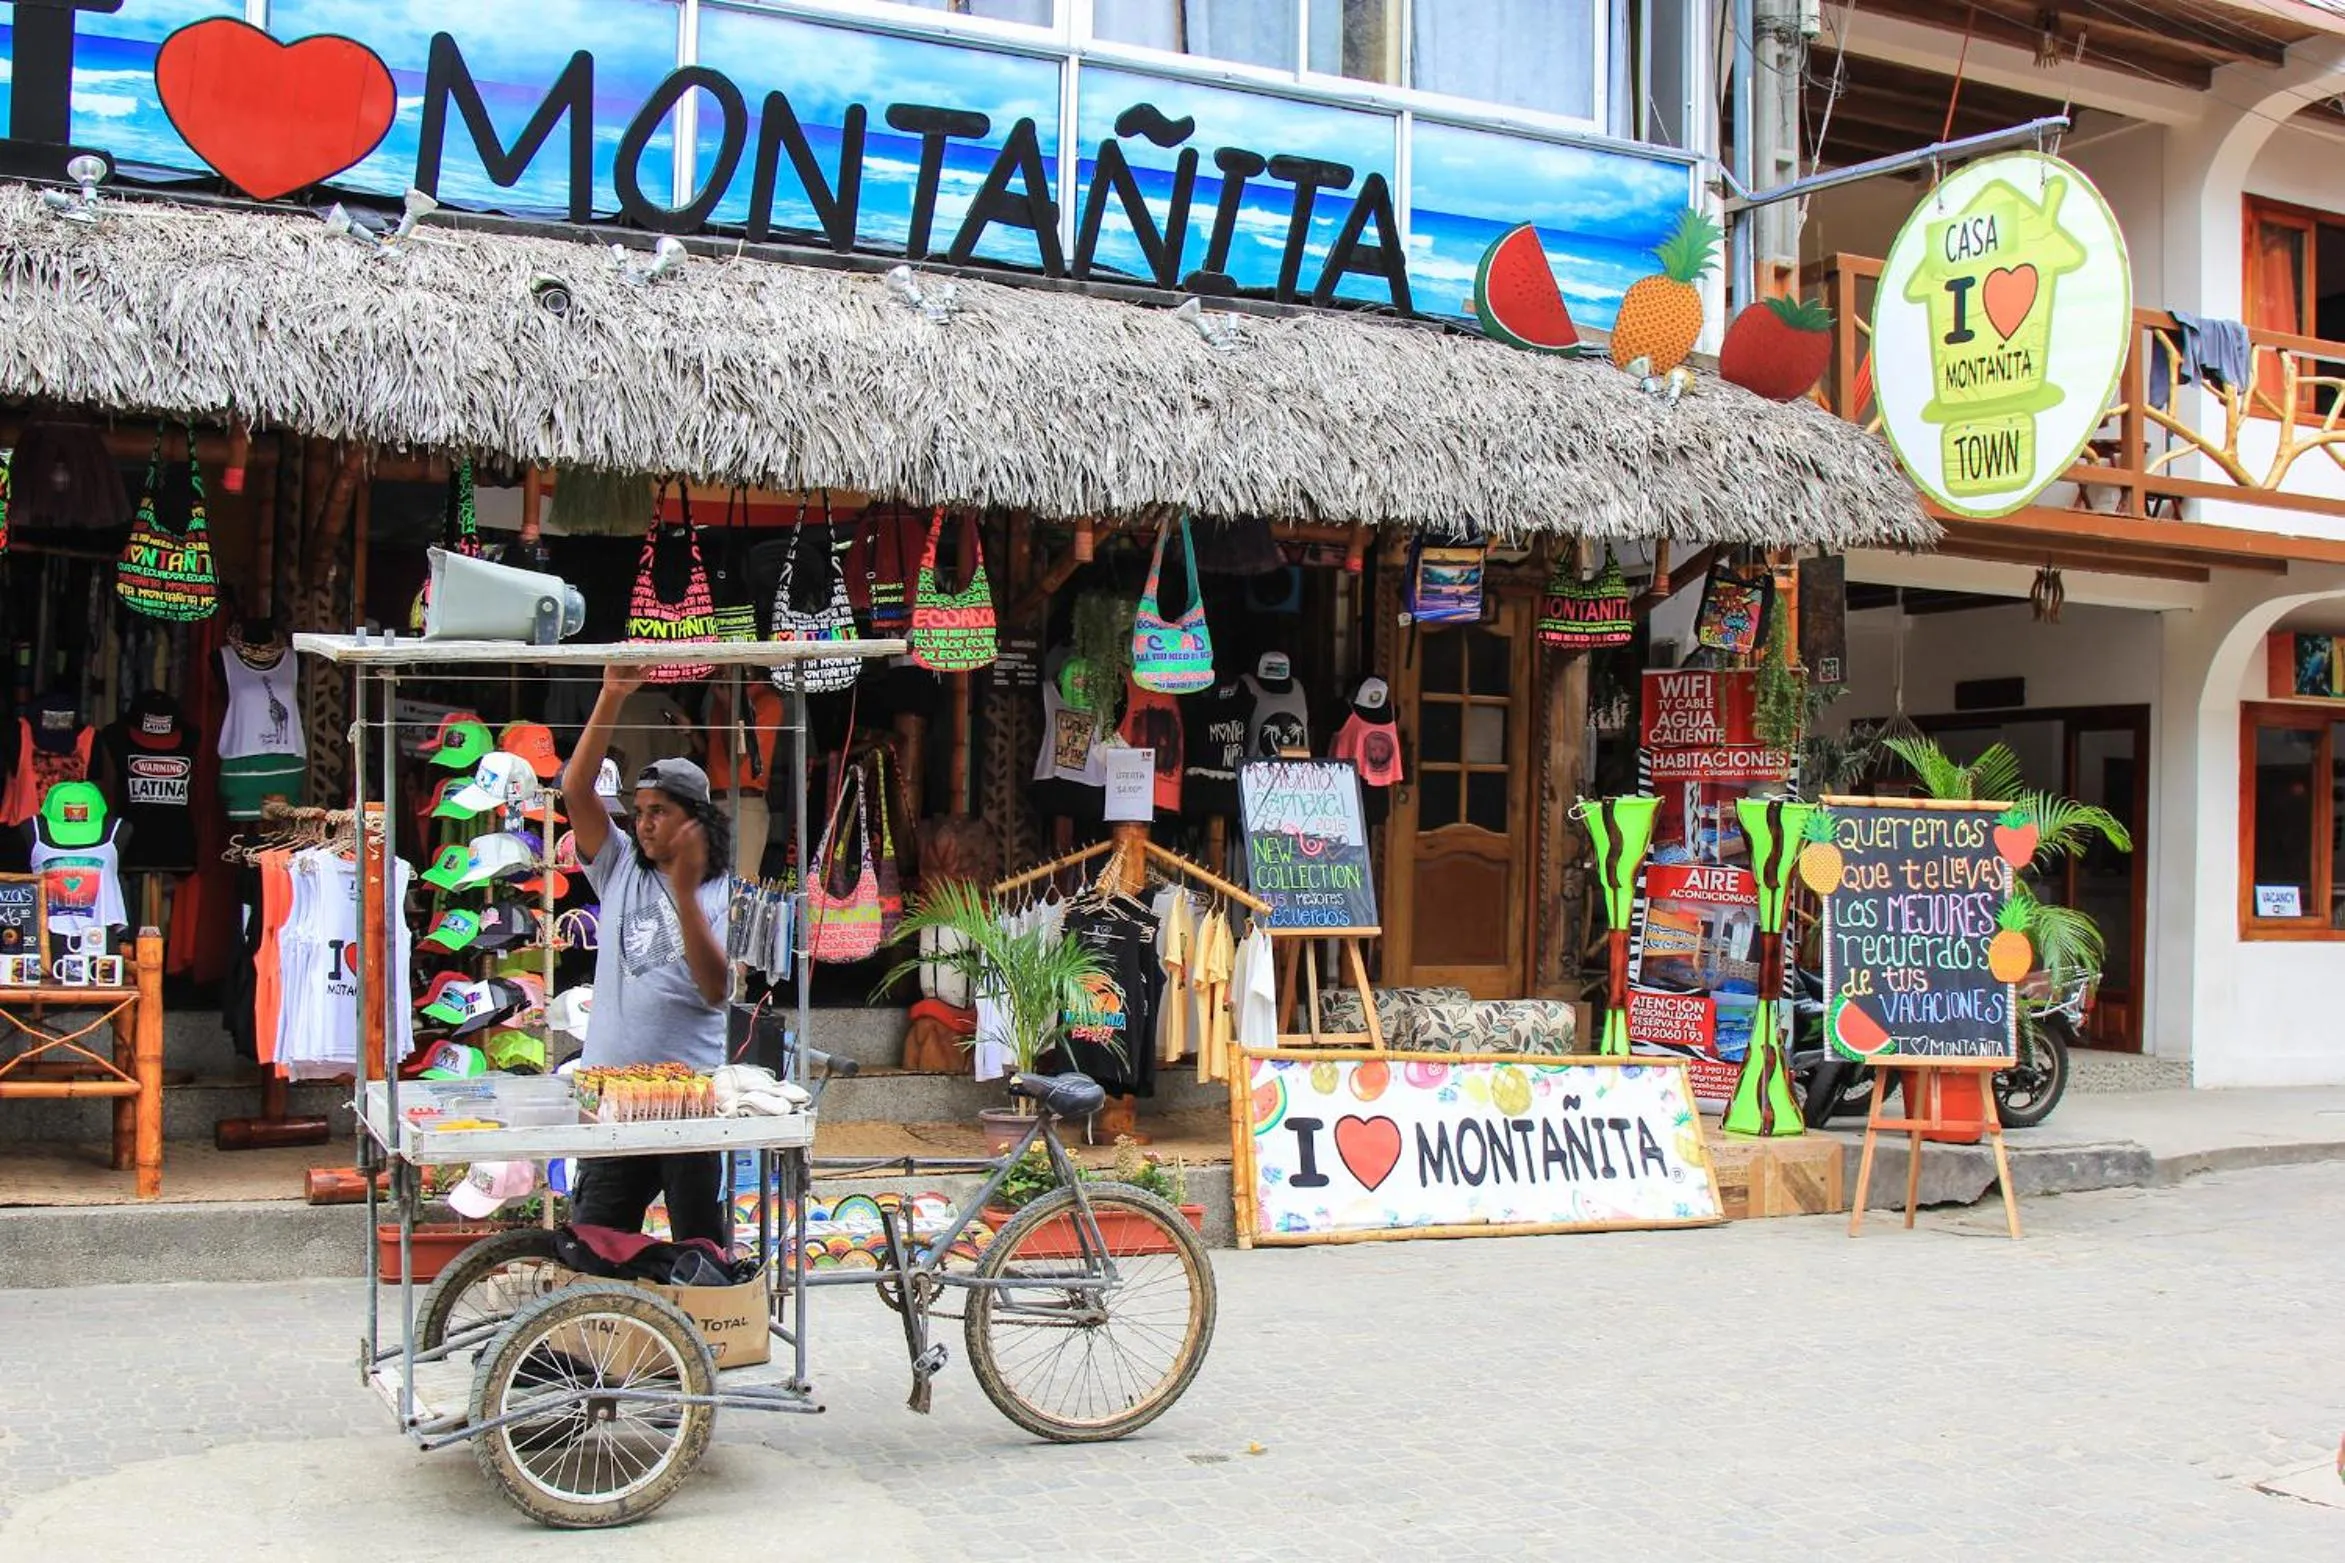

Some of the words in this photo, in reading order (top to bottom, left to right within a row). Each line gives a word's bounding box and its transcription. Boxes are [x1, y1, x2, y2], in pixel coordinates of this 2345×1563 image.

[0, 0, 124, 186] I
[414, 31, 1414, 315] MONTAÑITA
[1945, 214, 1998, 263] CASA
[1944, 275, 1976, 345] I
[1945, 344, 2032, 391] MONTAÑITA
[1954, 430, 2020, 481] TOWN
[1658, 675, 1711, 698] WIFI
[1658, 699, 1671, 709] TV
[1675, 698, 1714, 709] CABLE
[1656, 711, 1716, 728] AGUA
[138, 762, 183, 774] WARNING
[1653, 751, 1788, 769] HABITACIONES
[131, 780, 185, 798] LATINA
[1254, 837, 1293, 864] NEW
[1256, 864, 1362, 890] COLLECTION
[1684, 869, 1739, 892] AIRE
[1886, 892, 1995, 938] MEJORES
[328, 939, 345, 980] I
[1841, 968, 1874, 998] de
[1630, 1008, 1703, 1022] PERSONALIZADA
[1631, 996, 1705, 1013] ATENCIÓN
[1630, 1027, 1704, 1042] (04)2060193
[1632, 1017, 1681, 1029] RESERVAS
[1684, 1021, 1698, 1031] AL
[1930, 1037, 2004, 1057] MONTAÑITA
[1284, 1116, 1330, 1187] I
[1415, 1094, 1668, 1189] MONTAÑITA
[701, 1317, 749, 1331] TOTAL
